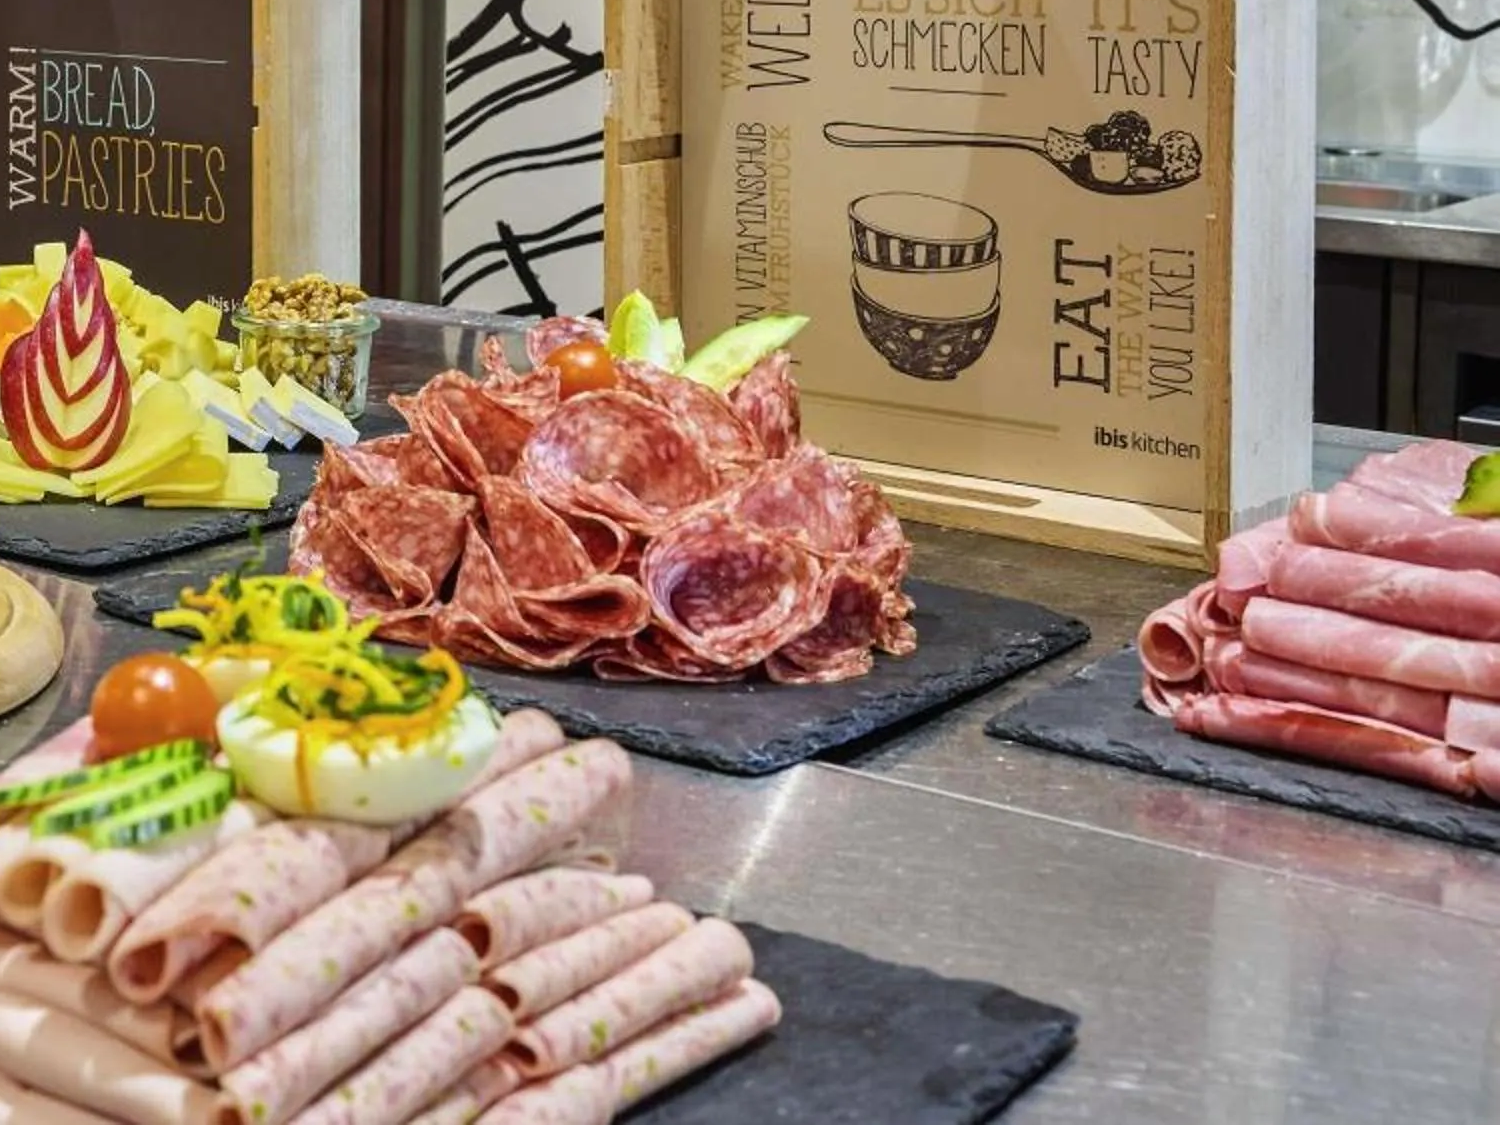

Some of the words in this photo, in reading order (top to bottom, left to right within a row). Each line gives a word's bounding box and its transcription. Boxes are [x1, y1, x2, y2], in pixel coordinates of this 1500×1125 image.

[721, 0, 743, 91] WAKE
[853, 18, 1046, 77] SCHMECKEN
[1087, 36, 1203, 99] TASTY
[8, 46, 37, 210] WARM!
[41, 60, 155, 136] BREAD,
[42, 130, 226, 224] PASTRIES
[735, 122, 767, 291] VITAMINSCHUB
[1054, 238, 1112, 394] EAT
[1117, 243, 1143, 323] WAY
[1148, 248, 1195, 334] LIKE!
[1117, 331, 1143, 398] THE
[1148, 344, 1193, 400] YOU
[1094, 427, 1128, 449] ibis
[1131, 431, 1201, 460] kitchen
